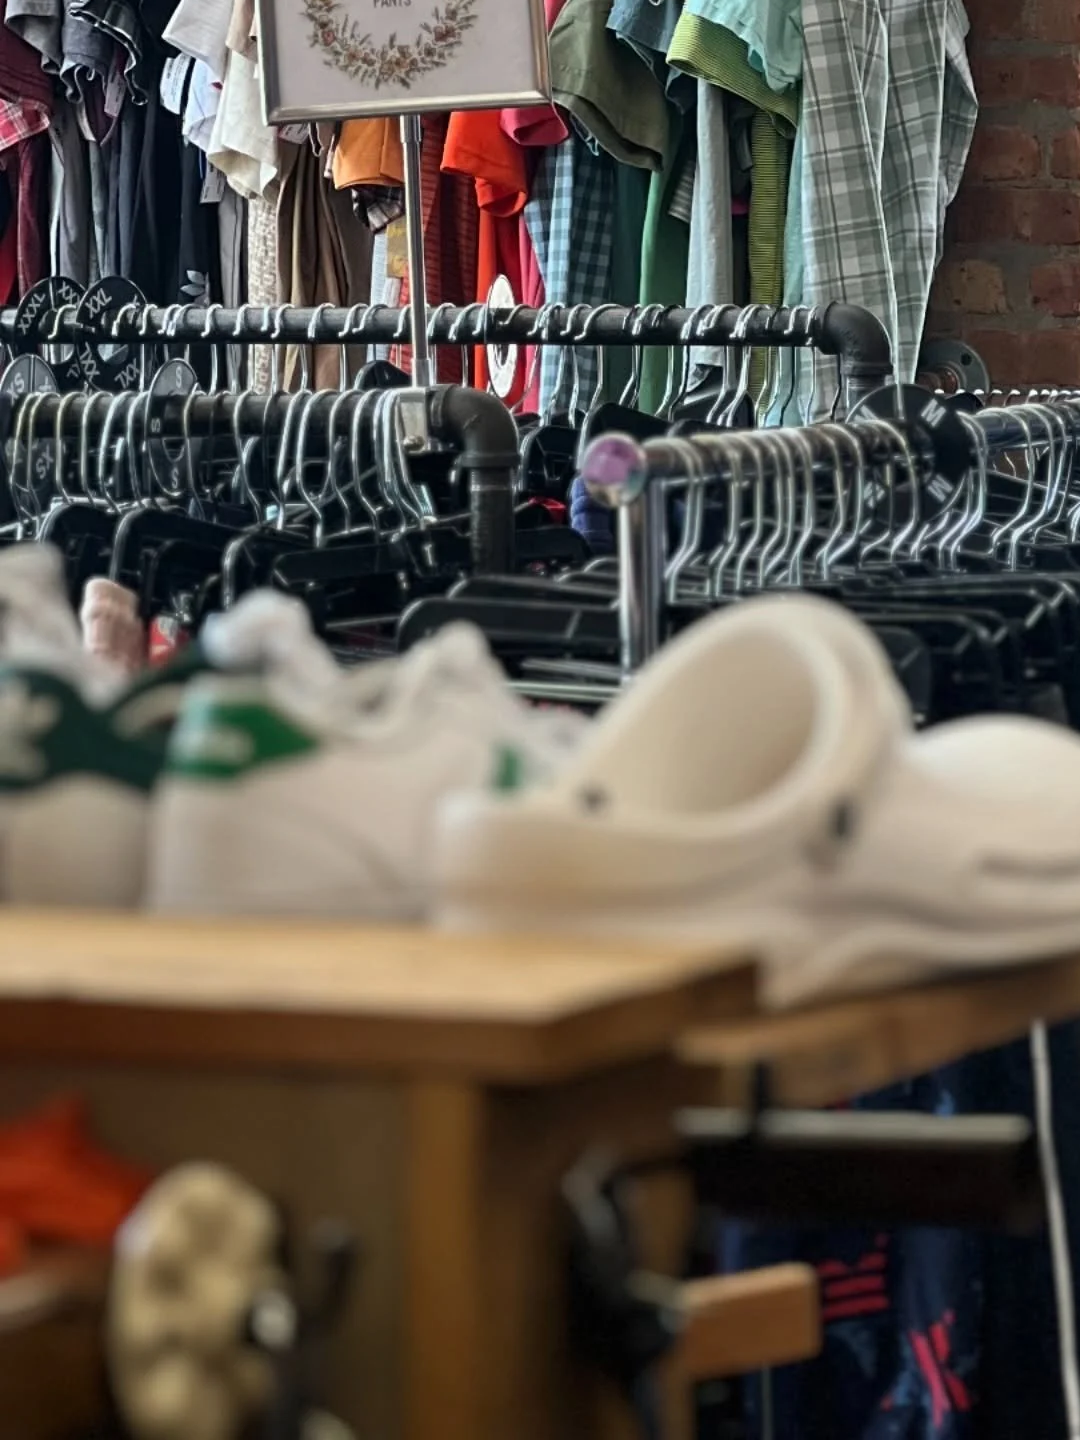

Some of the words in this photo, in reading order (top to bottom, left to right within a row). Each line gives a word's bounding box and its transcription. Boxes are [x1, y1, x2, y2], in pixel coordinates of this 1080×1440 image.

[18, 292, 46, 335] XXXL
[84, 287, 112, 319] XXL
[7, 371, 25, 405] XS
[174, 364, 184, 389] S
[920, 397, 947, 428] M
